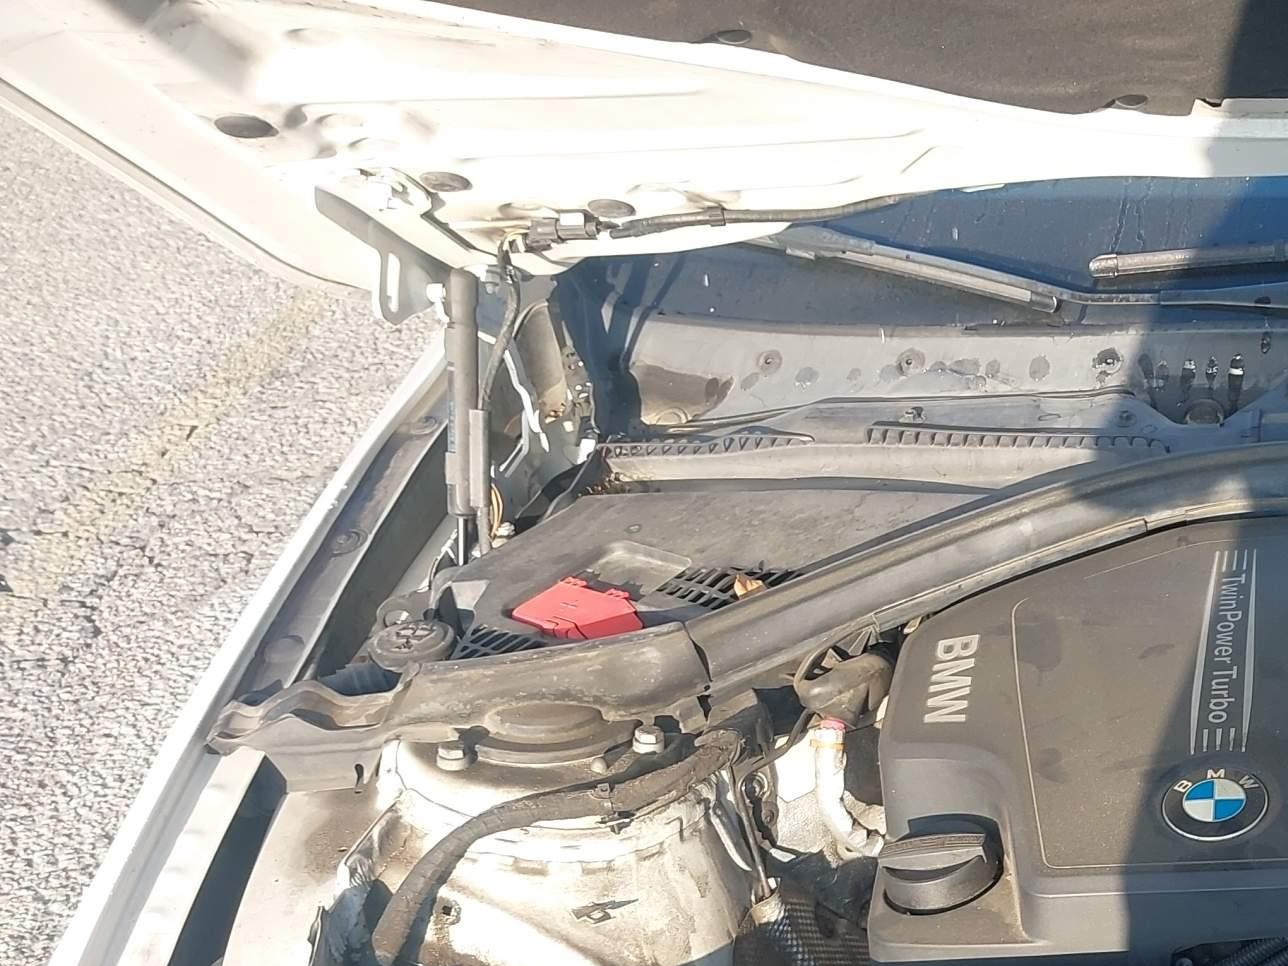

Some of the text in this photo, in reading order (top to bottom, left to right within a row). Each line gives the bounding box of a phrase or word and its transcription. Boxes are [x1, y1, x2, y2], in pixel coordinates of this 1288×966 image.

[923, 634, 981, 723] BMW
[1208, 573, 1245, 723] TwinPower Turbo
[1173, 769, 1261, 793] BMW
